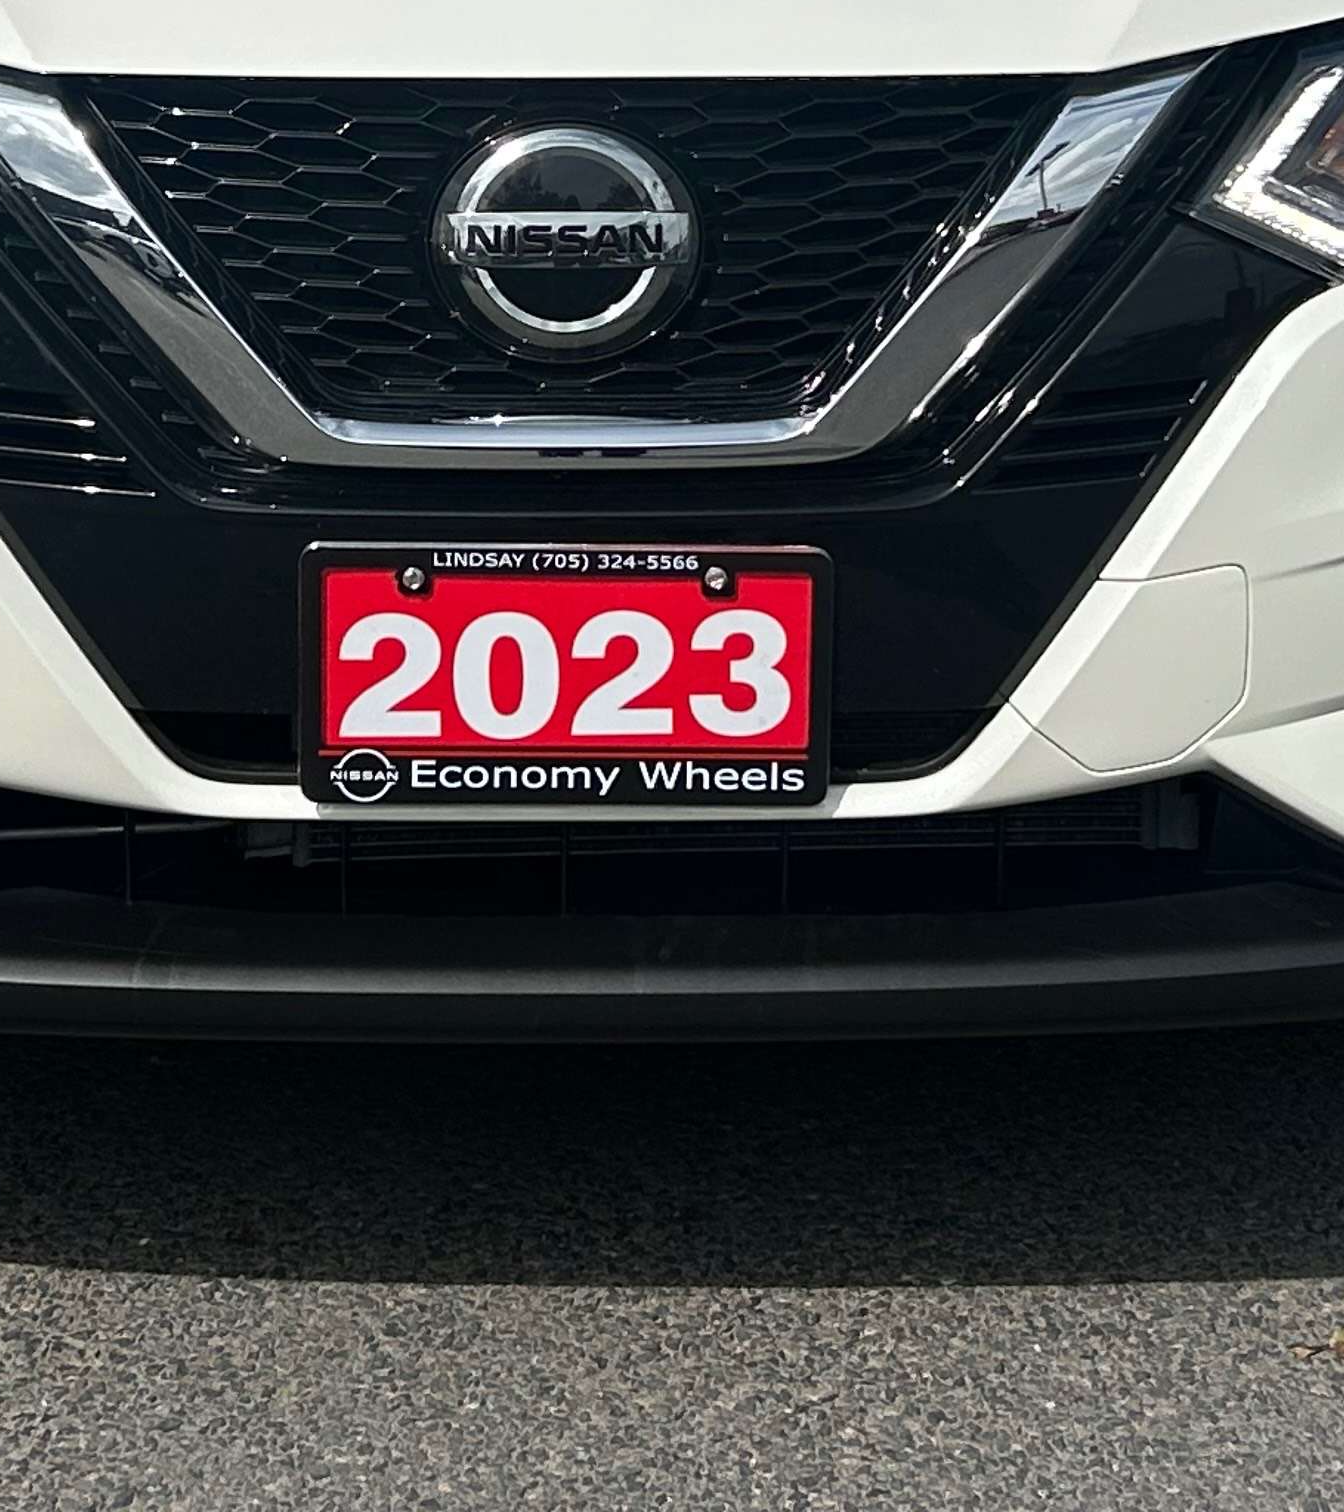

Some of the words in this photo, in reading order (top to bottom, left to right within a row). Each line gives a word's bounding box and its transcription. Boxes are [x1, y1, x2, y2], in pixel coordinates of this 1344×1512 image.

[464, 223, 664, 255] NISSAN
[433, 552, 525, 567] LINDSAY
[532, 553, 590, 572] (705)
[597, 554, 699, 570] 324-5566
[338, 608, 791, 740] 2023
[330, 770, 399, 781] NISSAN
[411, 759, 620, 796] Economy
[638, 760, 805, 792] Wheels
